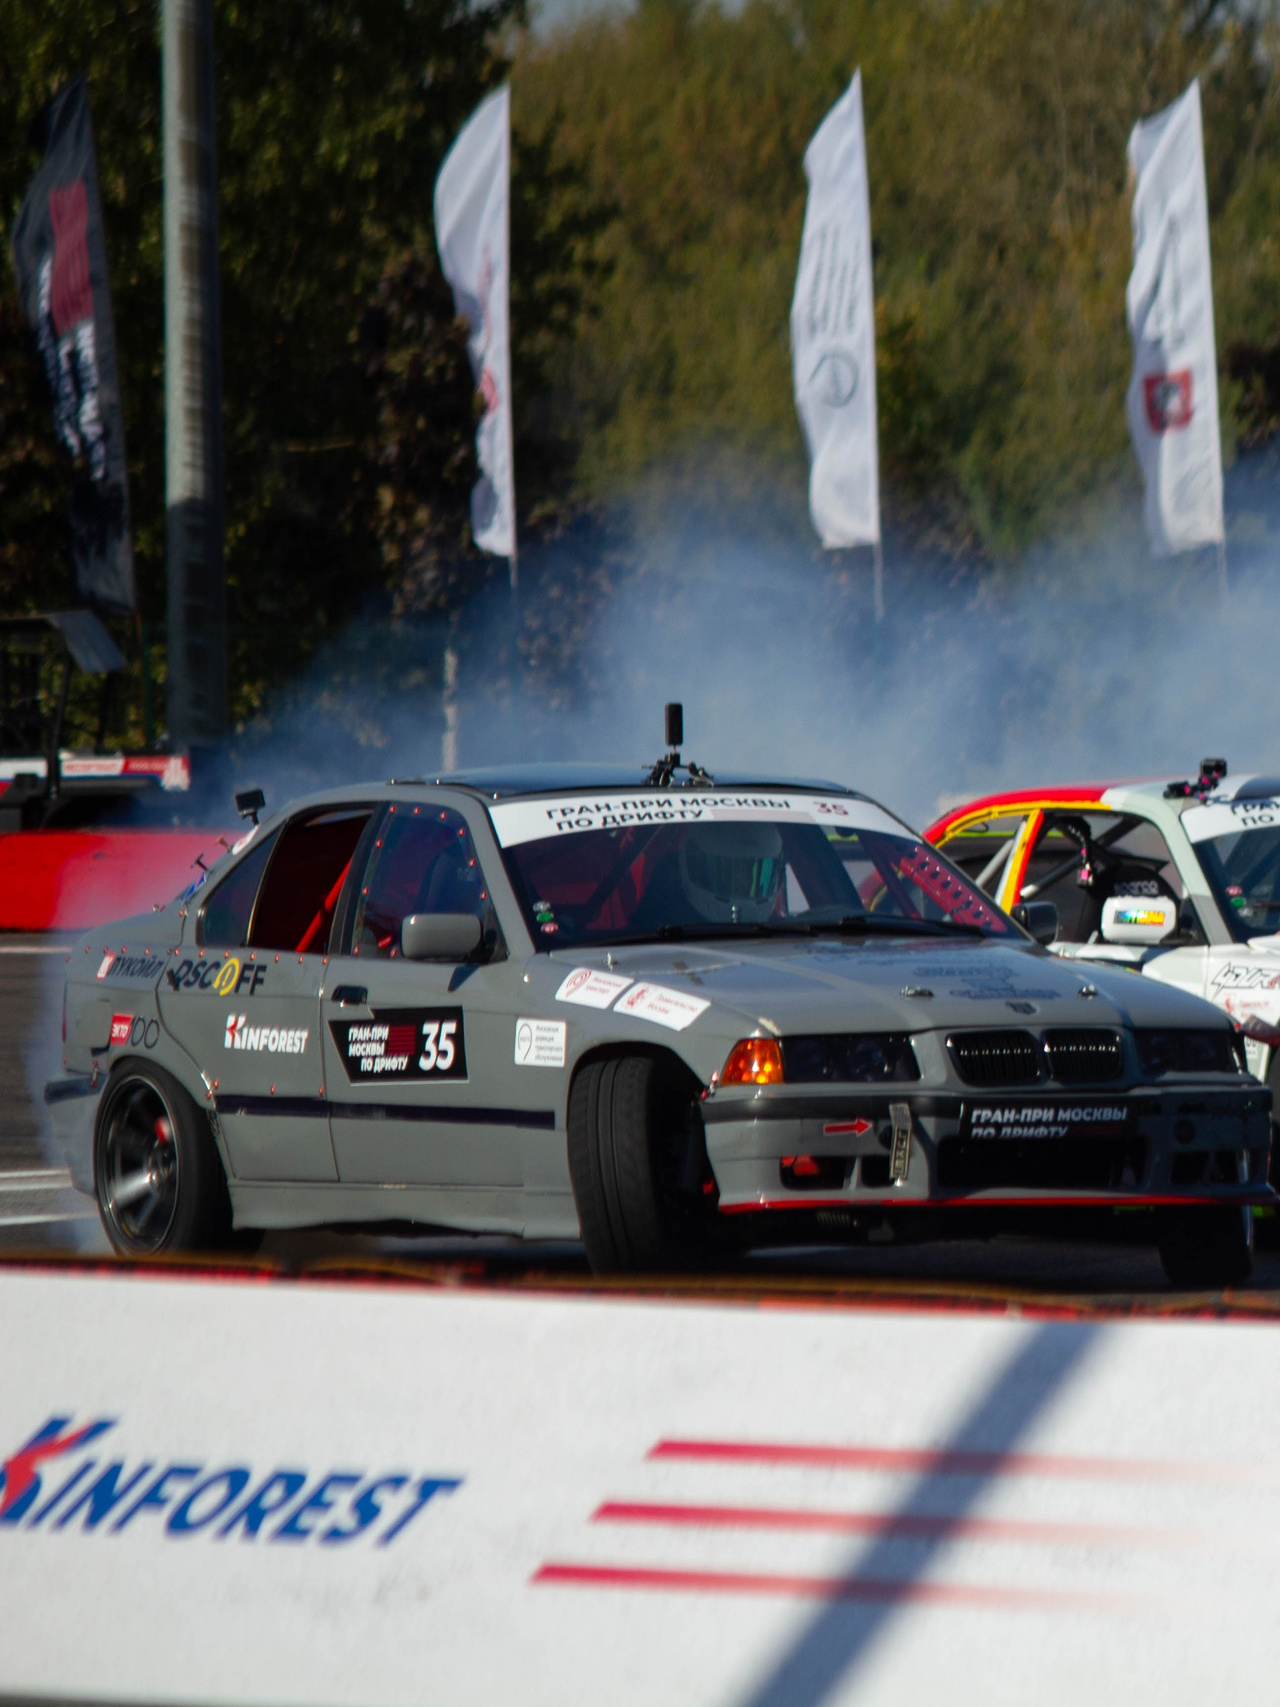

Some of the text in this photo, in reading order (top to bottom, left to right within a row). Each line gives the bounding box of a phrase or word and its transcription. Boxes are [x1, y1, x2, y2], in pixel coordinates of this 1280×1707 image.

[546, 797, 792, 820] ГРАН-ПРИ МОСКВЫ
[813, 800, 848, 817] 35
[556, 809, 703, 832] ПО ДРИФТУ
[1242, 814, 1275, 826] ПО
[107, 953, 164, 979] ЛУКОЙЛ
[111, 1023, 129, 1038] ЭКТО
[224, 1012, 309, 1054] KINFOREST
[348, 1024, 389, 1041] ГРАН-ПРИ
[348, 1042, 386, 1057] МОСКВЫ
[419, 1020, 457, 1071] 35
[361, 1055, 409, 1073] ПО ДРИФТУ
[970, 1107, 1128, 1124] ГРАН-ПРИ МОСКВЫ
[970, 1126, 1069, 1139] ПО ДРИФТУ
[0, 1415, 468, 1549] KINFOREST
